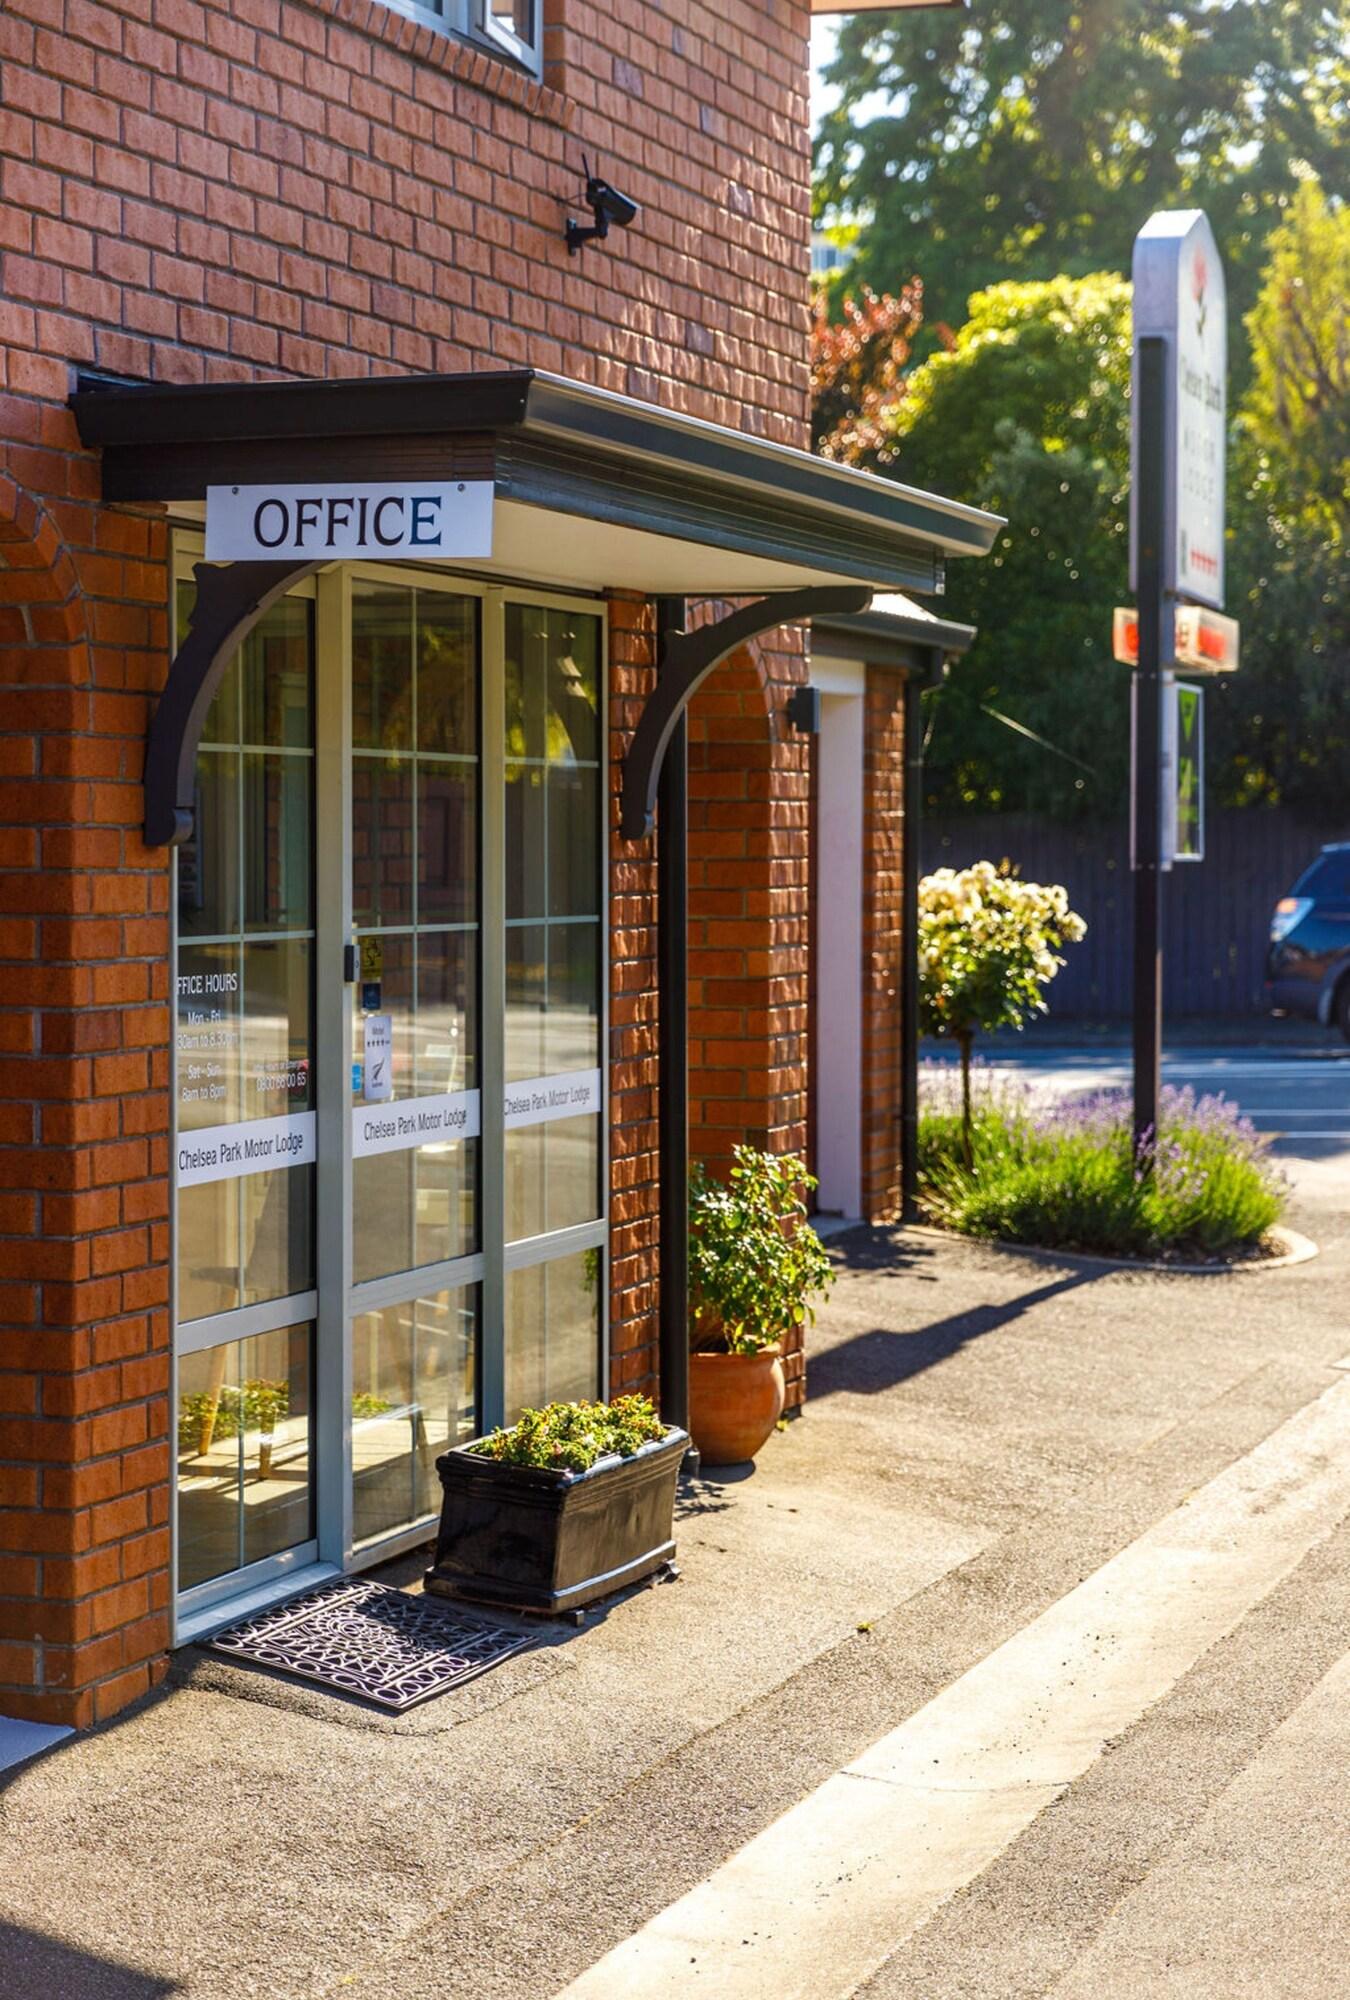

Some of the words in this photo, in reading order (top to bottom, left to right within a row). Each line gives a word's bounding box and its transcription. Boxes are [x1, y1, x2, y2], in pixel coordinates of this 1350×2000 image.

[253, 496, 442, 548] OFFICE
[177, 976, 203, 994] FFICE
[205, 973, 238, 992] HOURS
[187, 1011, 204, 1025] Mon
[210, 1009, 221, 1024] Fri
[504, 1097, 530, 1115] Chelsea
[532, 1091, 547, 1110] Park
[548, 1090, 569, 1106] Motor
[570, 1086, 591, 1104] Lodge
[364, 1120, 396, 1141] Chelsea
[398, 1115, 417, 1135] Park
[418, 1112, 442, 1131] Motor
[444, 1108, 466, 1129] Lodge
[178, 1148, 217, 1170] Chelsea
[220, 1141, 242, 1163] Park
[244, 1138, 273, 1159] Motor
[275, 1132, 303, 1155] Lodge
